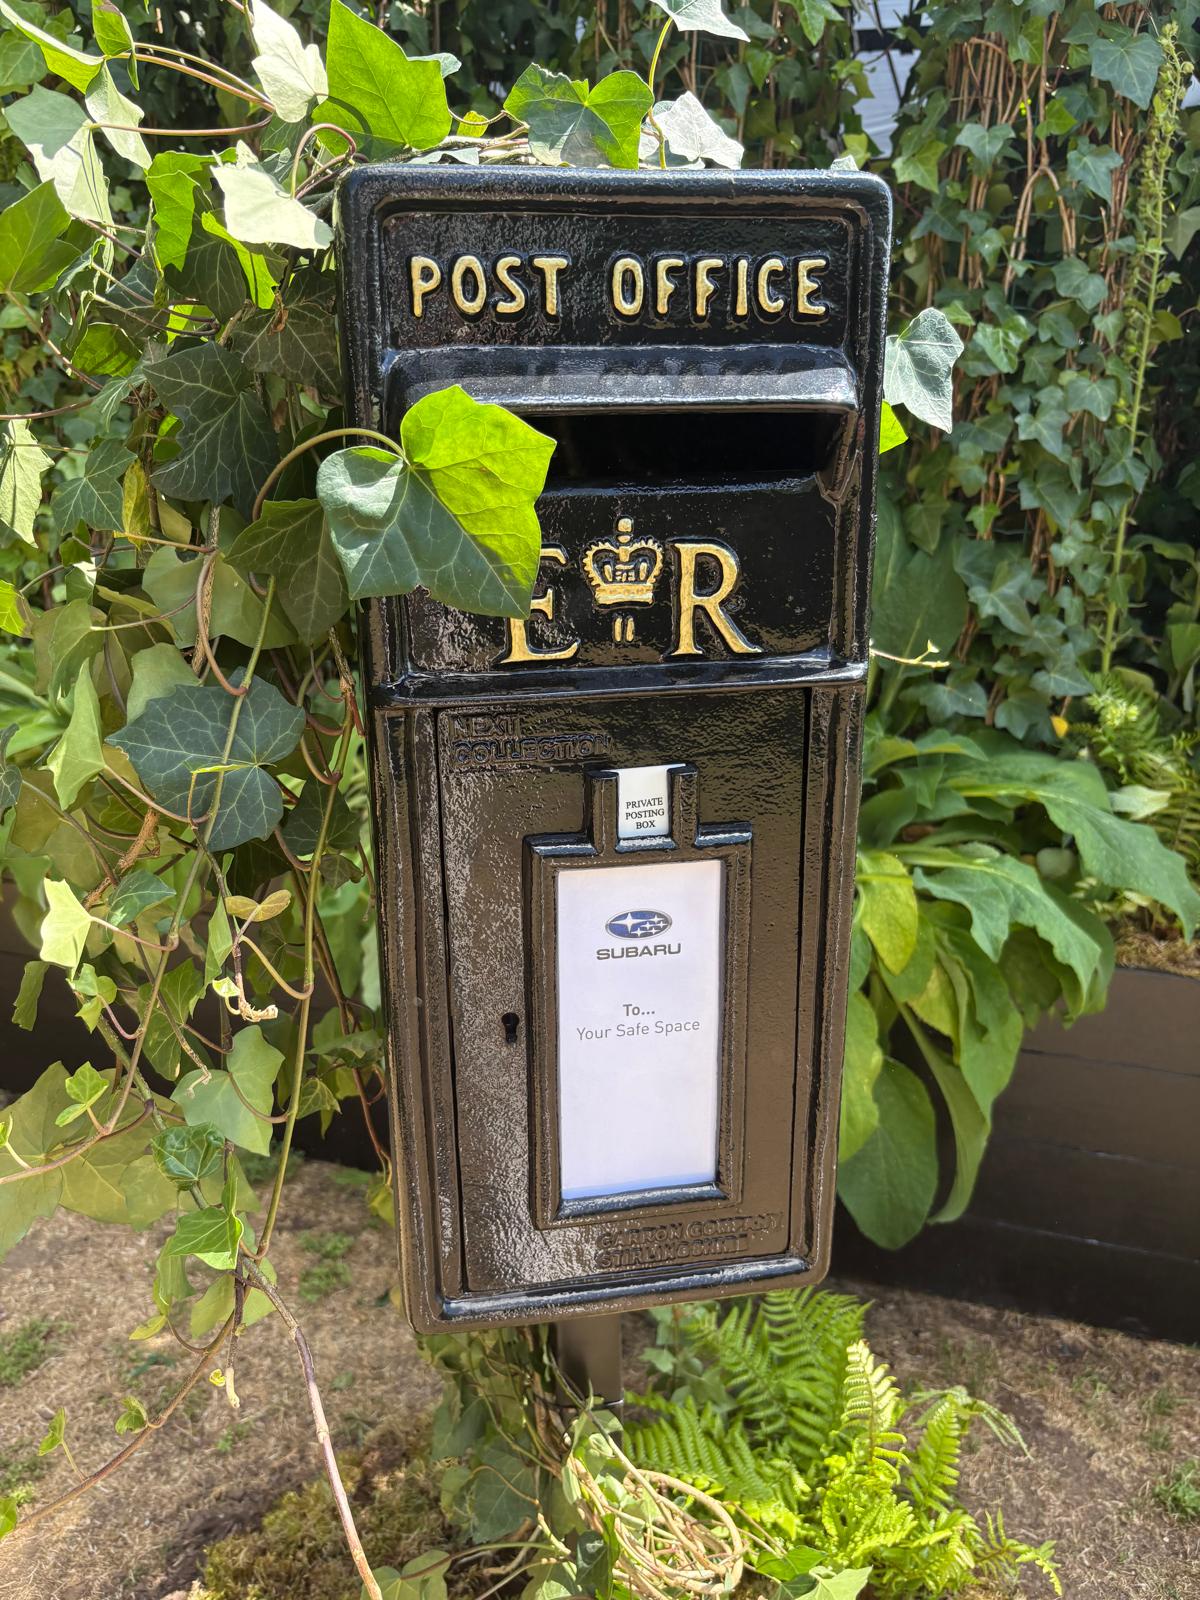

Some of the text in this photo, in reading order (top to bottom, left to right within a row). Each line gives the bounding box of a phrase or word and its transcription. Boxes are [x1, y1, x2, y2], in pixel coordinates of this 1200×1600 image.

[411, 255, 827, 317] POST OFFICE
[500, 542, 763, 664] E R
[451, 715, 521, 738] NEXT
[452, 735, 613, 763] COLLECTION
[625, 797, 663, 809] PRIVATE
[625, 808, 665, 820] POSTING
[636, 820, 656, 830] BOX
[596, 943, 682, 960] SUBARU
[623, 1004, 656, 1016] To...
[576, 1020, 701, 1041] Your Safe Space
